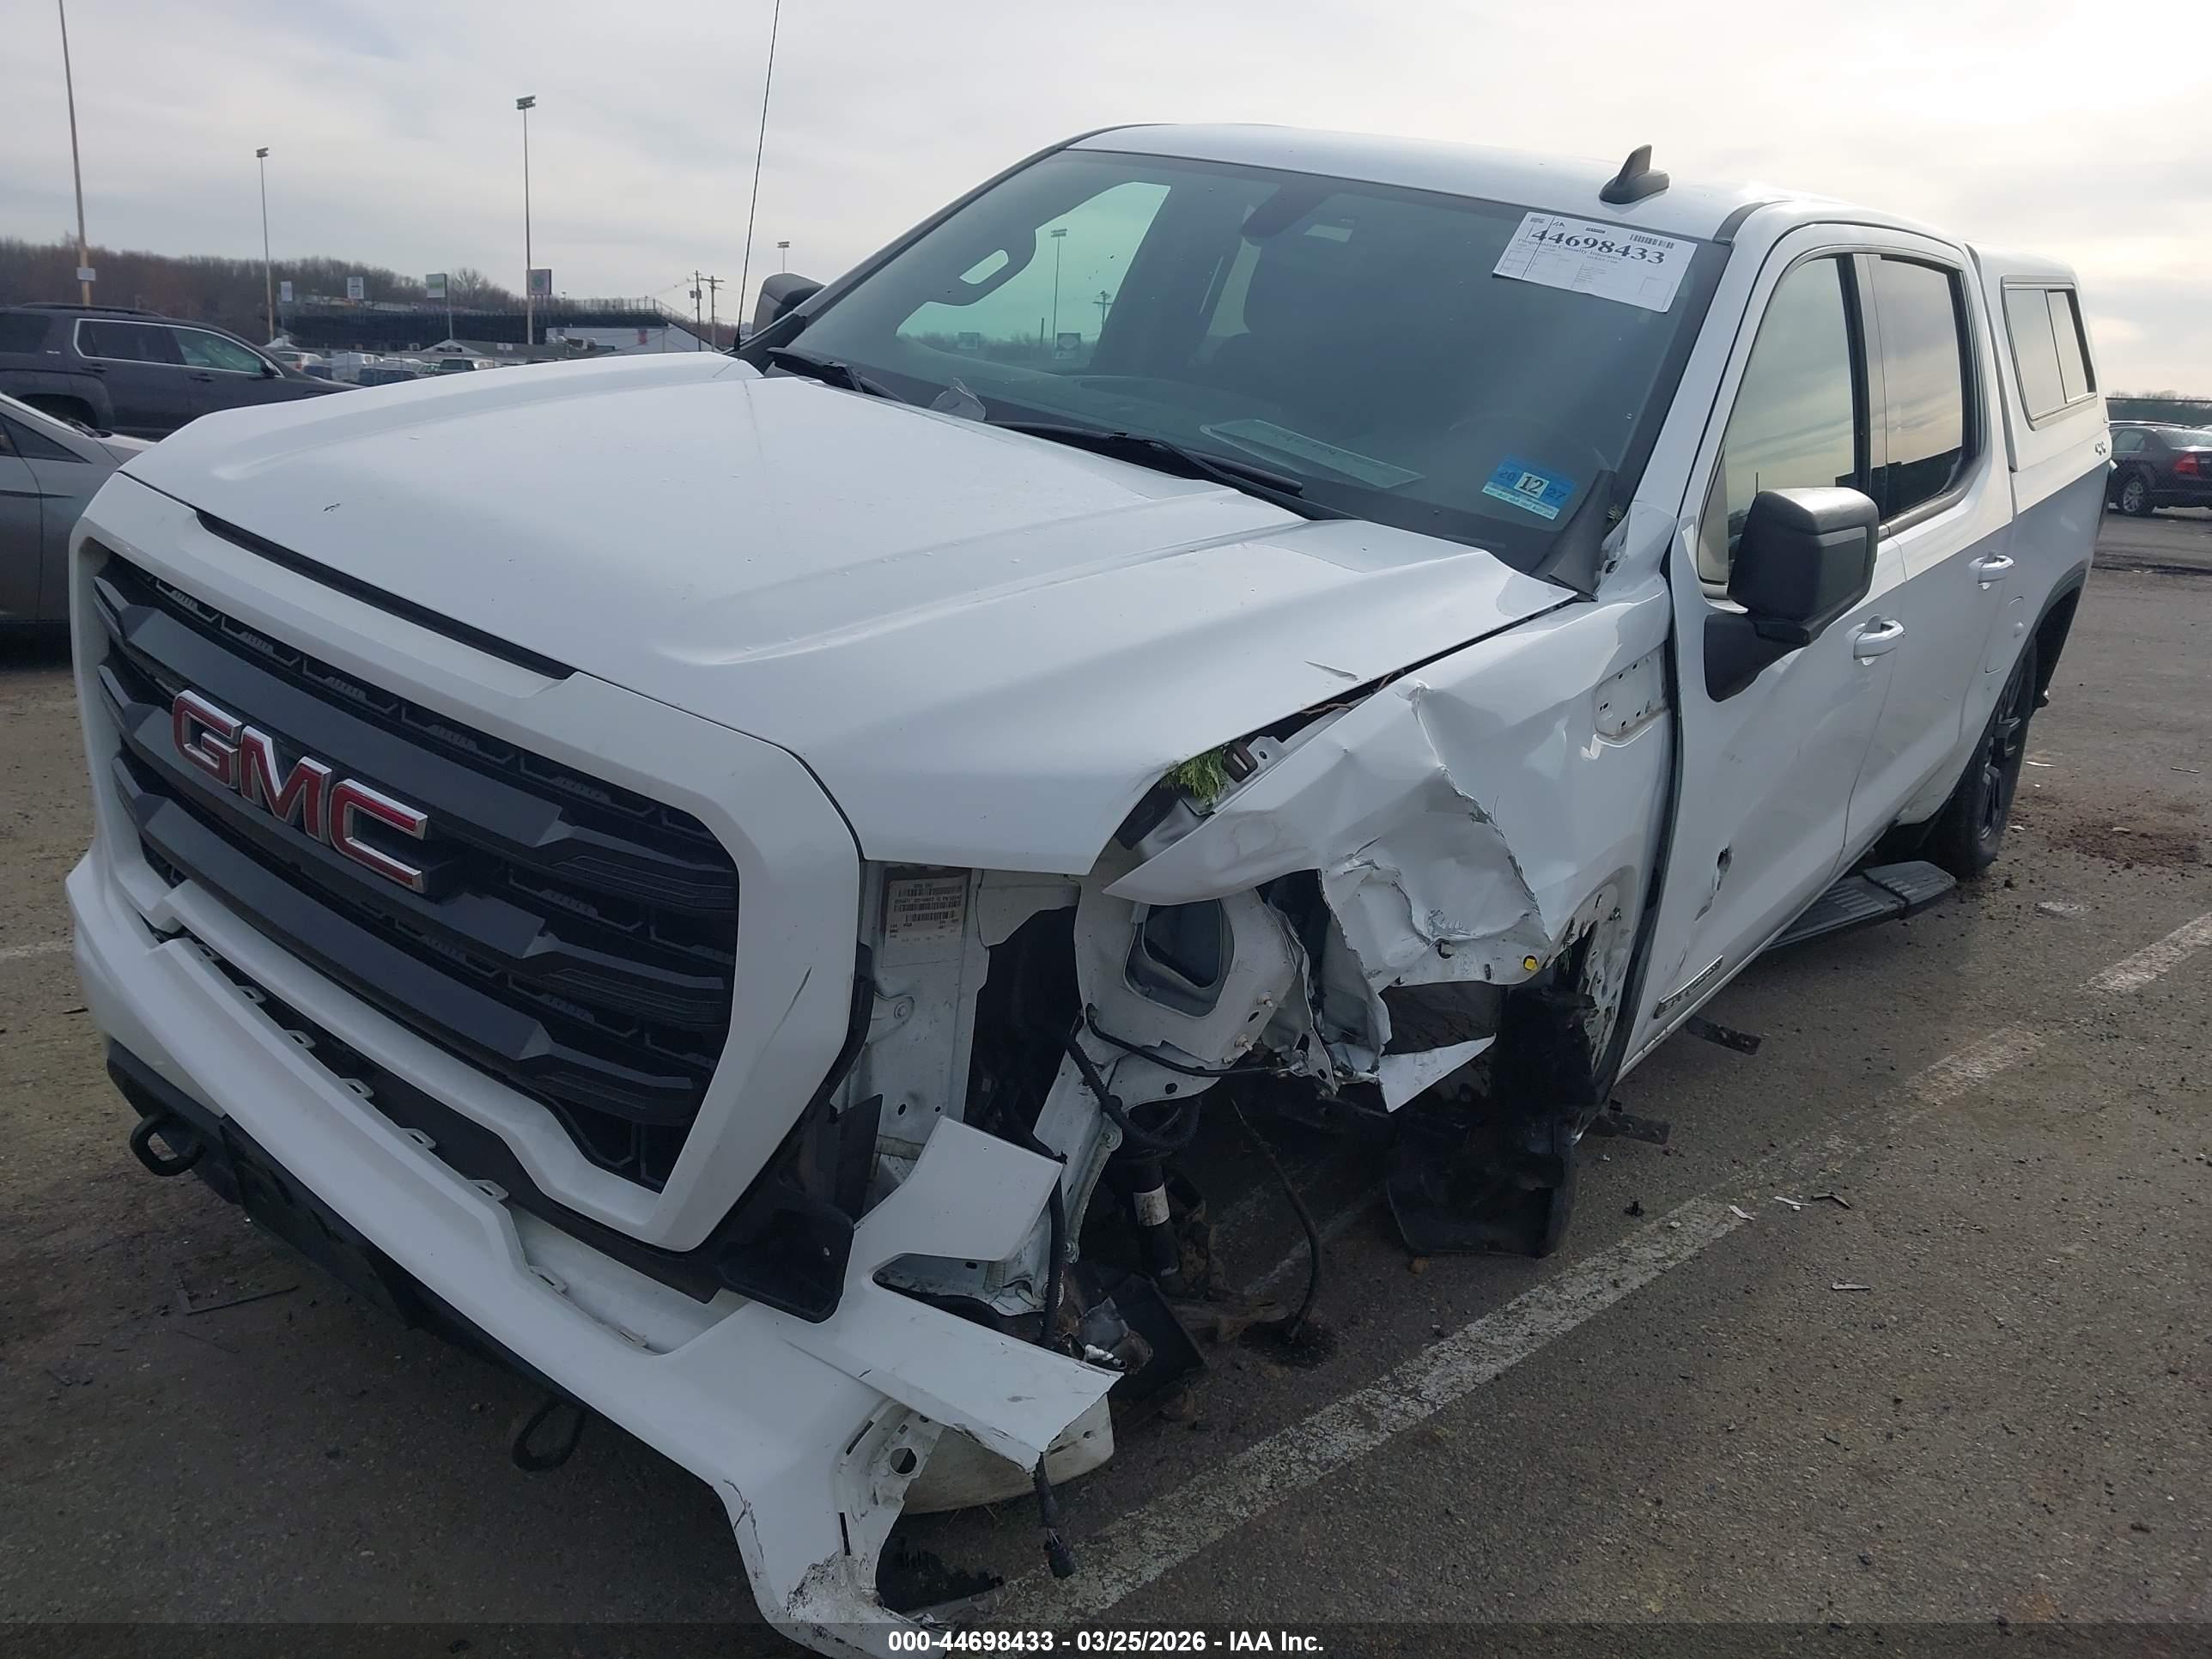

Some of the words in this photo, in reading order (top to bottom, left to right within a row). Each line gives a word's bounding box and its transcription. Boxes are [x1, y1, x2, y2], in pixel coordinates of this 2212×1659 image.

[1531, 229, 1666, 264] 44698433
[1498, 470, 1516, 482] 20
[1519, 476, 1544, 495] 12
[1545, 488, 1566, 500] 27
[173, 690, 428, 894] GMC
